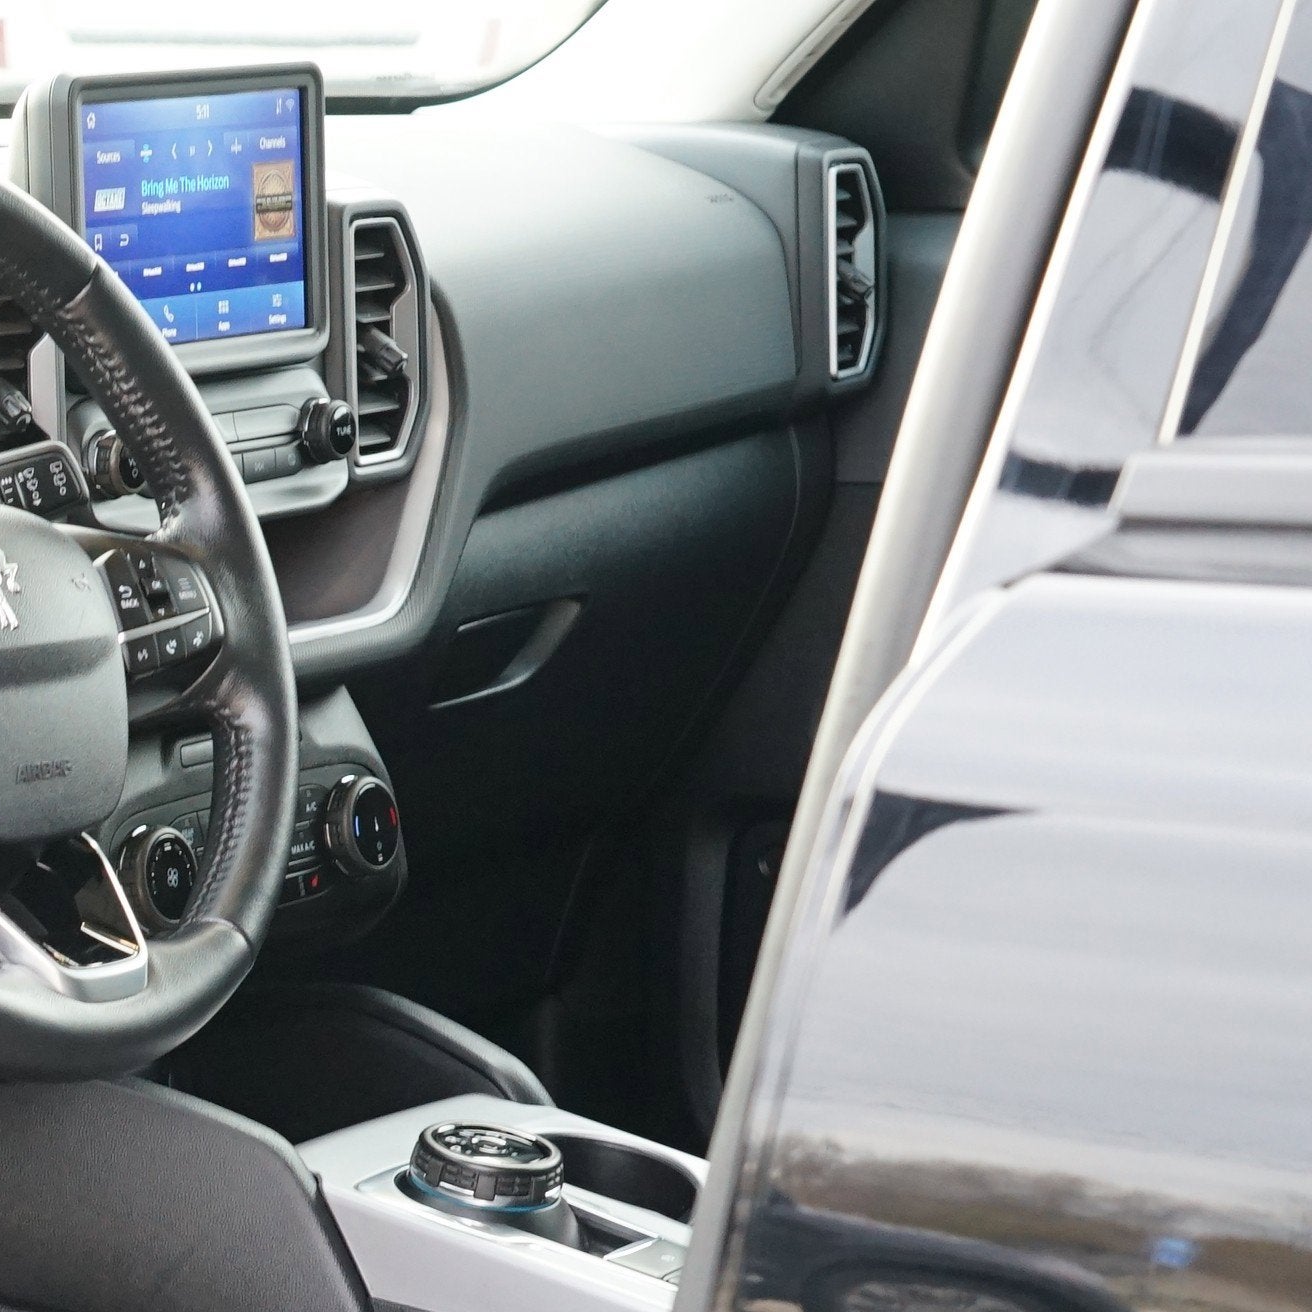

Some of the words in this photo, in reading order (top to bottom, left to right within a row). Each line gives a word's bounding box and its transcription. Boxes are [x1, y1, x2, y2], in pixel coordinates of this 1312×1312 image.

[260, 136, 286, 149] Channels
[96, 150, 121, 164] Sources
[141, 179, 164, 197] Bring
[165, 178, 178, 194] Me
[179, 176, 196, 192] The
[197, 174, 230, 190] Horizon
